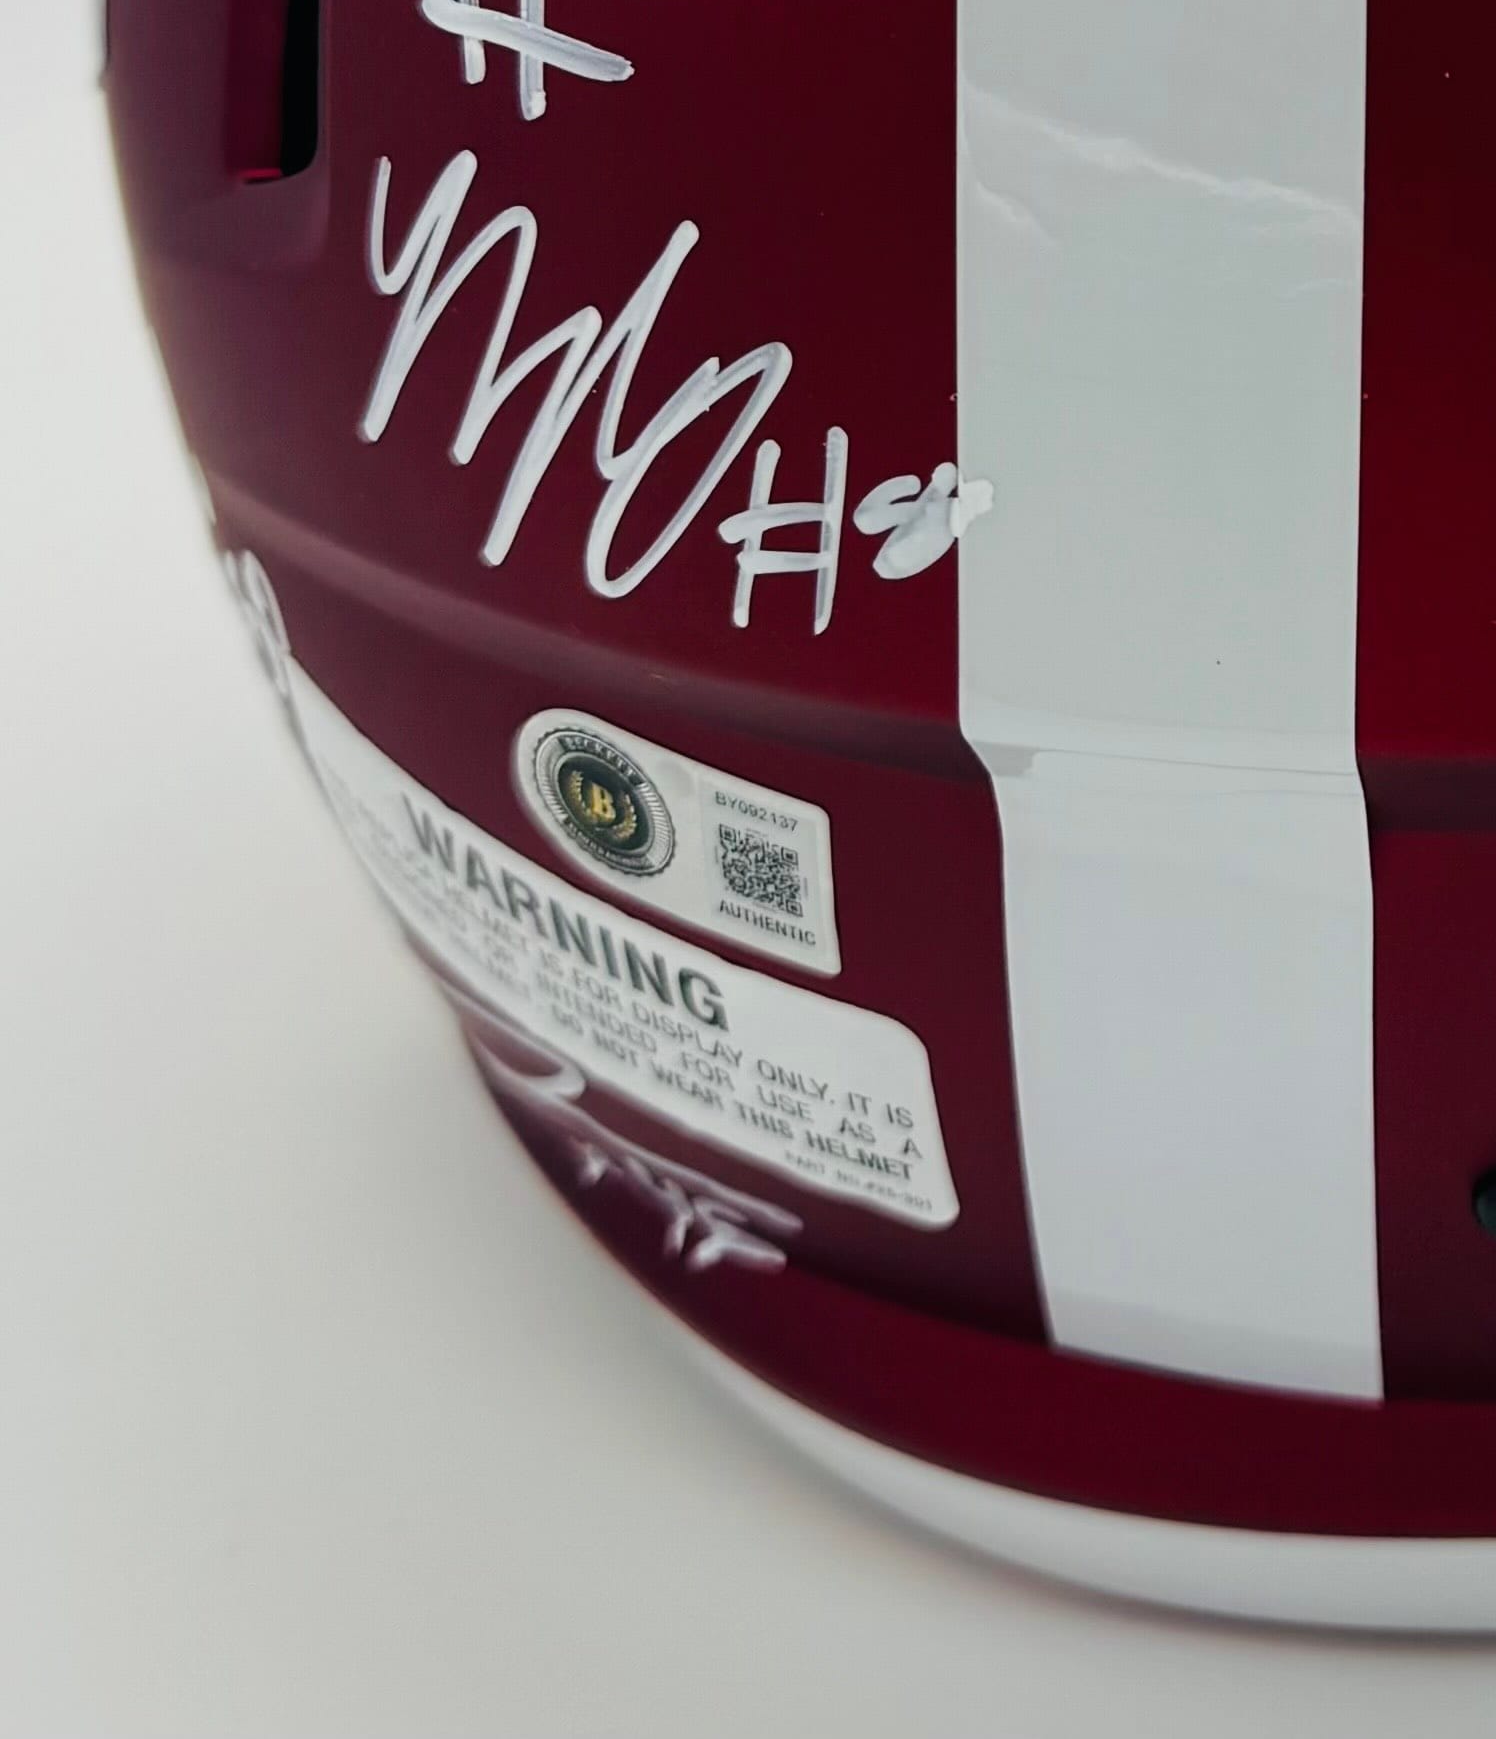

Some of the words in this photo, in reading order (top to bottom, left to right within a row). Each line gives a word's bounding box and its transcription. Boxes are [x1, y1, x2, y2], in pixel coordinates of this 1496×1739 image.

[401, 790, 731, 1033] WARNING
[719, 899, 817, 947] AUTHENTIC
[572, 968, 624, 1013] FOR
[632, 1000, 744, 1069] DISPLAY
[757, 1059, 835, 1106] ONLY.
[848, 1091, 872, 1118] IT
[886, 1102, 914, 1131] IS
[681, 1050, 736, 1092] FOR
[757, 1084, 814, 1124] USE
[839, 1116, 877, 1145] AS
[903, 1138, 923, 1160] A
[650, 1060, 724, 1112] WEAR
[732, 1101, 794, 1141] THIS
[805, 1129, 914, 1181] HELMET
